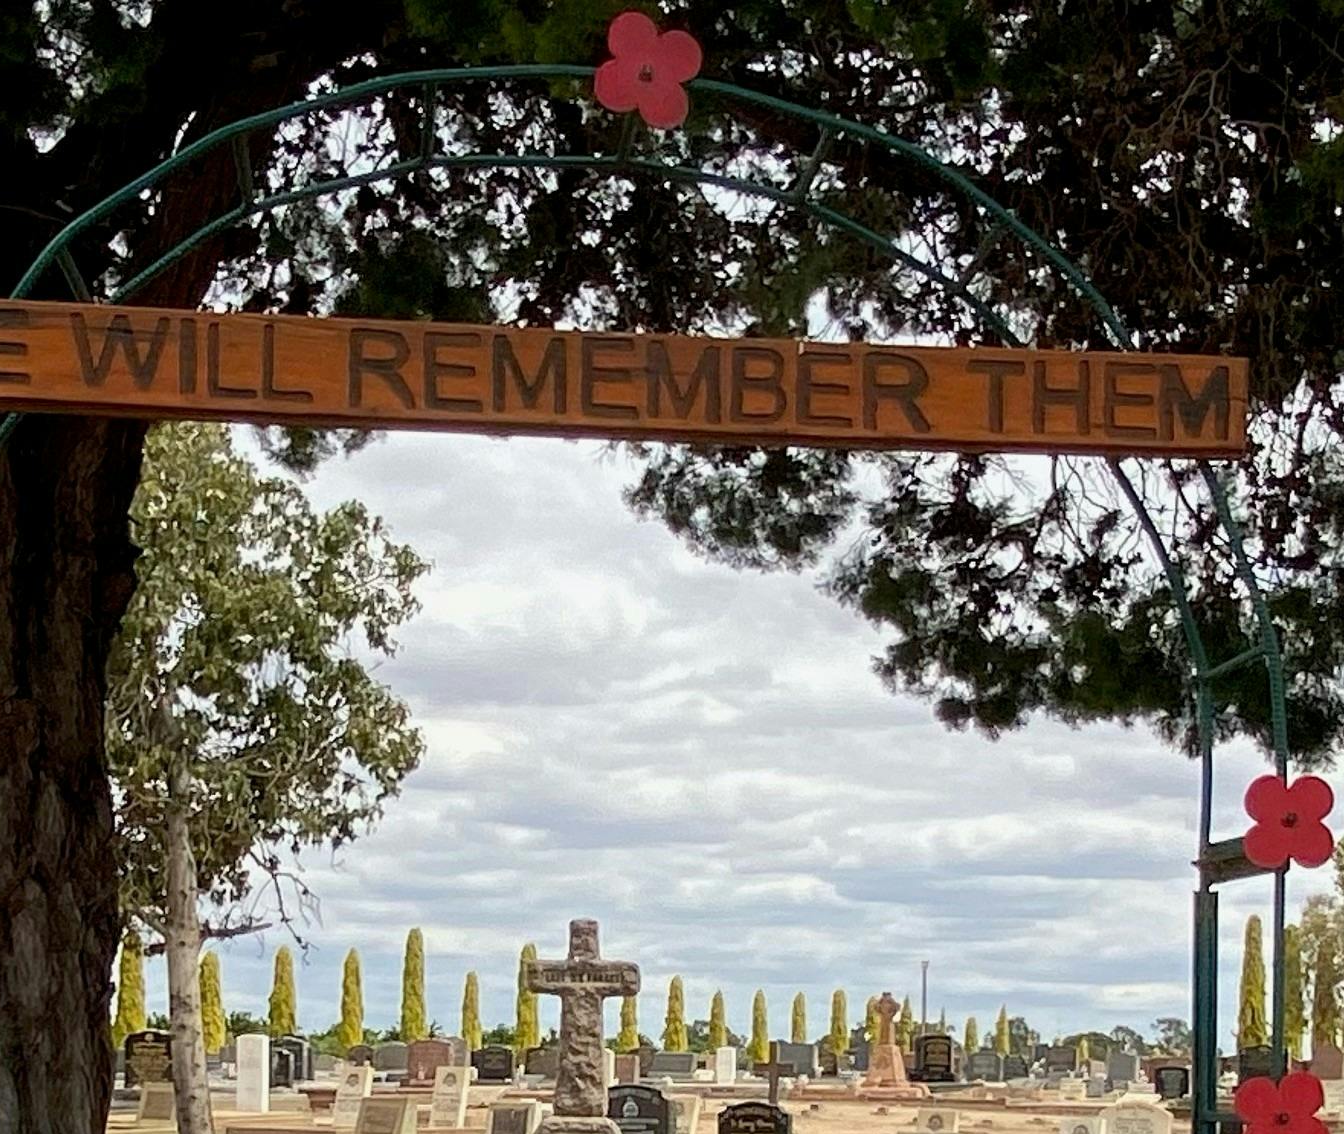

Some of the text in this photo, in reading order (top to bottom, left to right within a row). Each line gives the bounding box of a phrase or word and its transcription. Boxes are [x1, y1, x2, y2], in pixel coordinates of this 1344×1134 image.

[69, 310, 314, 402] WILL
[347, 327, 933, 433] REMEMBER
[966, 358, 1230, 443] THEM
